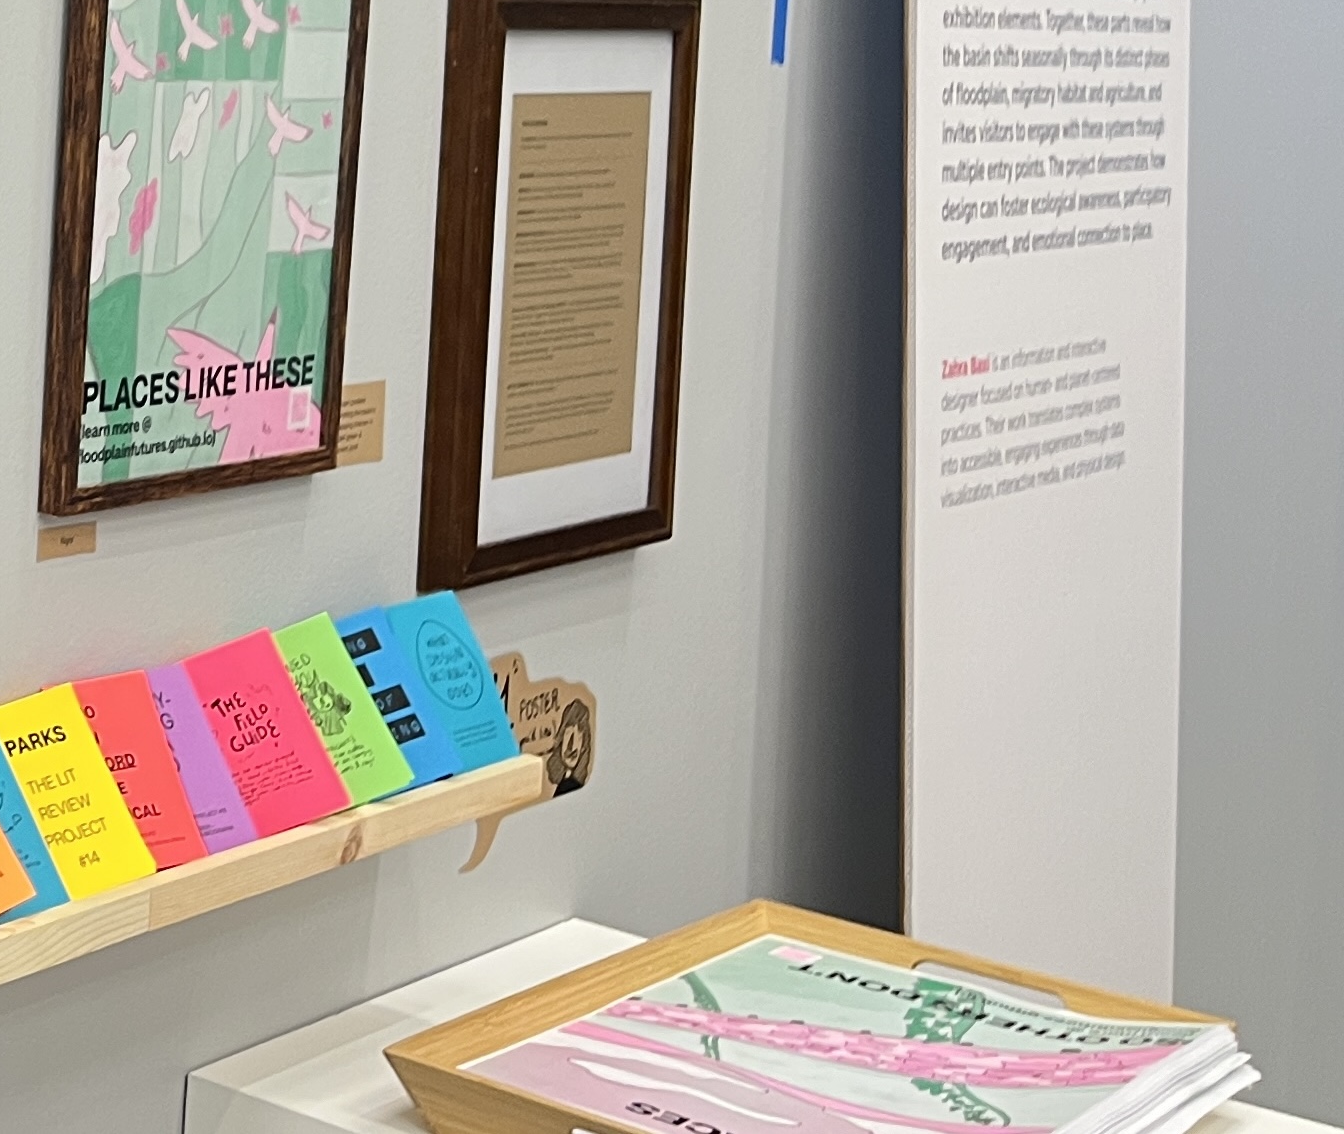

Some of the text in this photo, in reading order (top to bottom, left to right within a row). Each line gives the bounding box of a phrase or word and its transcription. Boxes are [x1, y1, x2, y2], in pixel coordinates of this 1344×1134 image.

[82, 354, 315, 415] PLACES LIKE THESE
[112, 419, 140, 435] more
[211, 691, 246, 717] THE
[4, 725, 67, 758] PARKS
[229, 718, 280, 754] GUIDE
[26, 767, 78, 797] THE LIT
[38, 793, 92, 821] REVIEW
[44, 816, 108, 848] PROJECT
